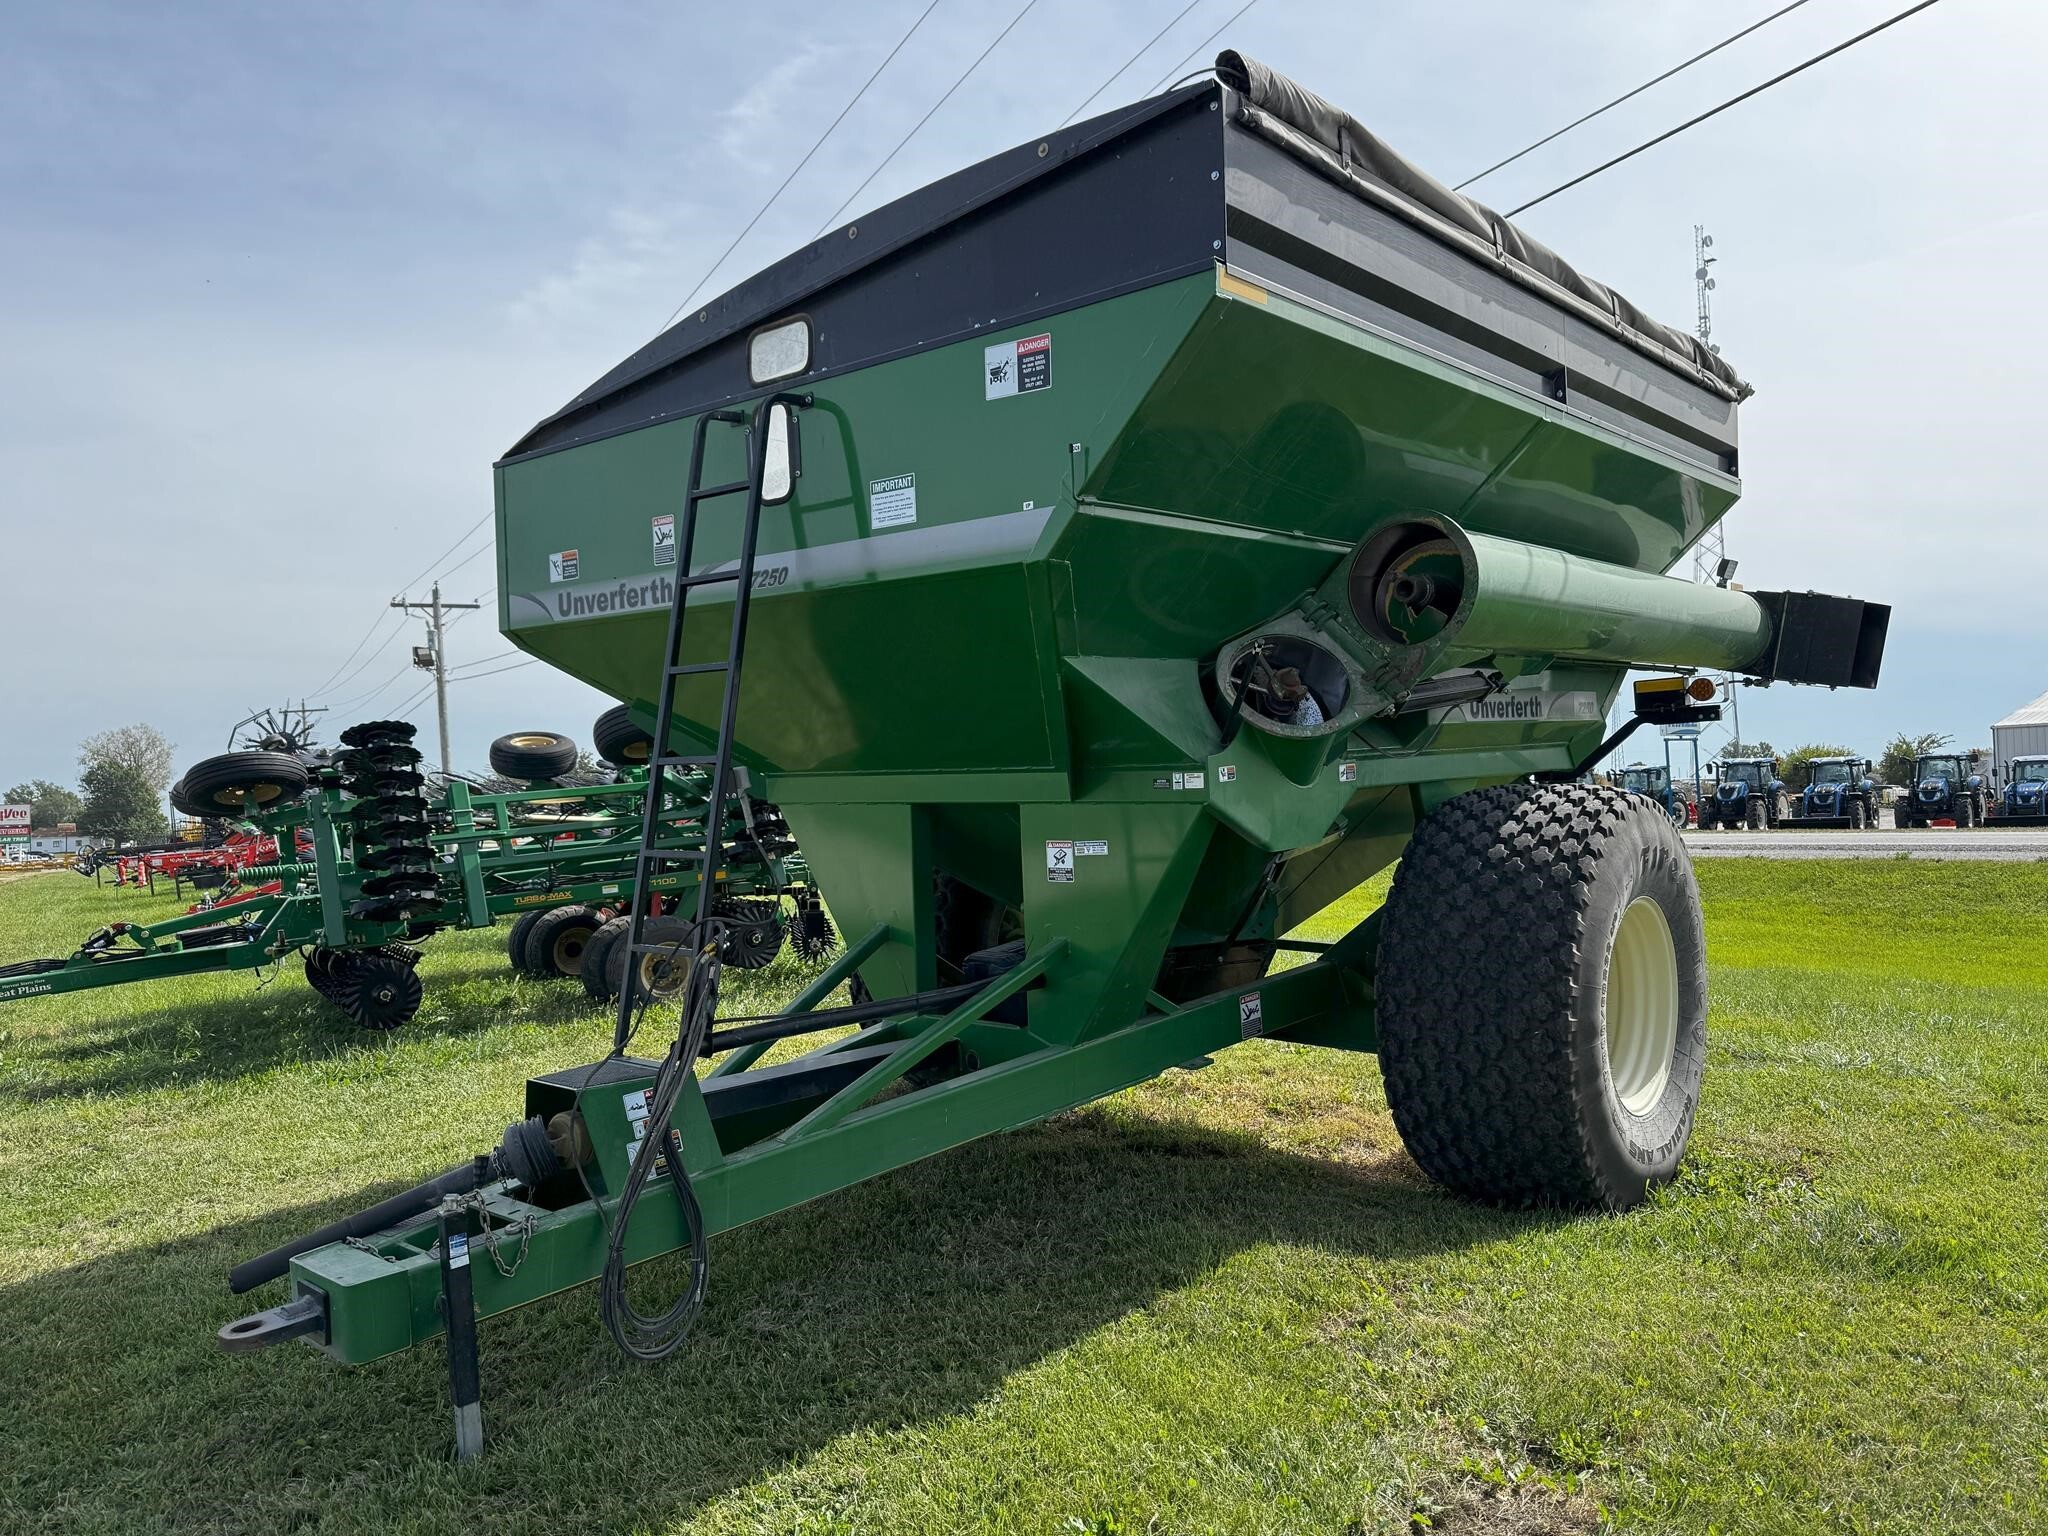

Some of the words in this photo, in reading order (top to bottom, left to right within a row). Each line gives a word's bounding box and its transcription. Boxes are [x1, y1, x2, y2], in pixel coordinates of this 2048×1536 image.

[1024, 338, 1049, 351] DANGER
[872, 477, 912, 494] IMPORTANT
[752, 567, 789, 589] 7250
[558, 577, 674, 618] Unverferth
[1470, 696, 1542, 720] Unverferth
[513, 891, 571, 904] TURBO-MAX
[17, 984, 52, 995] Plains
